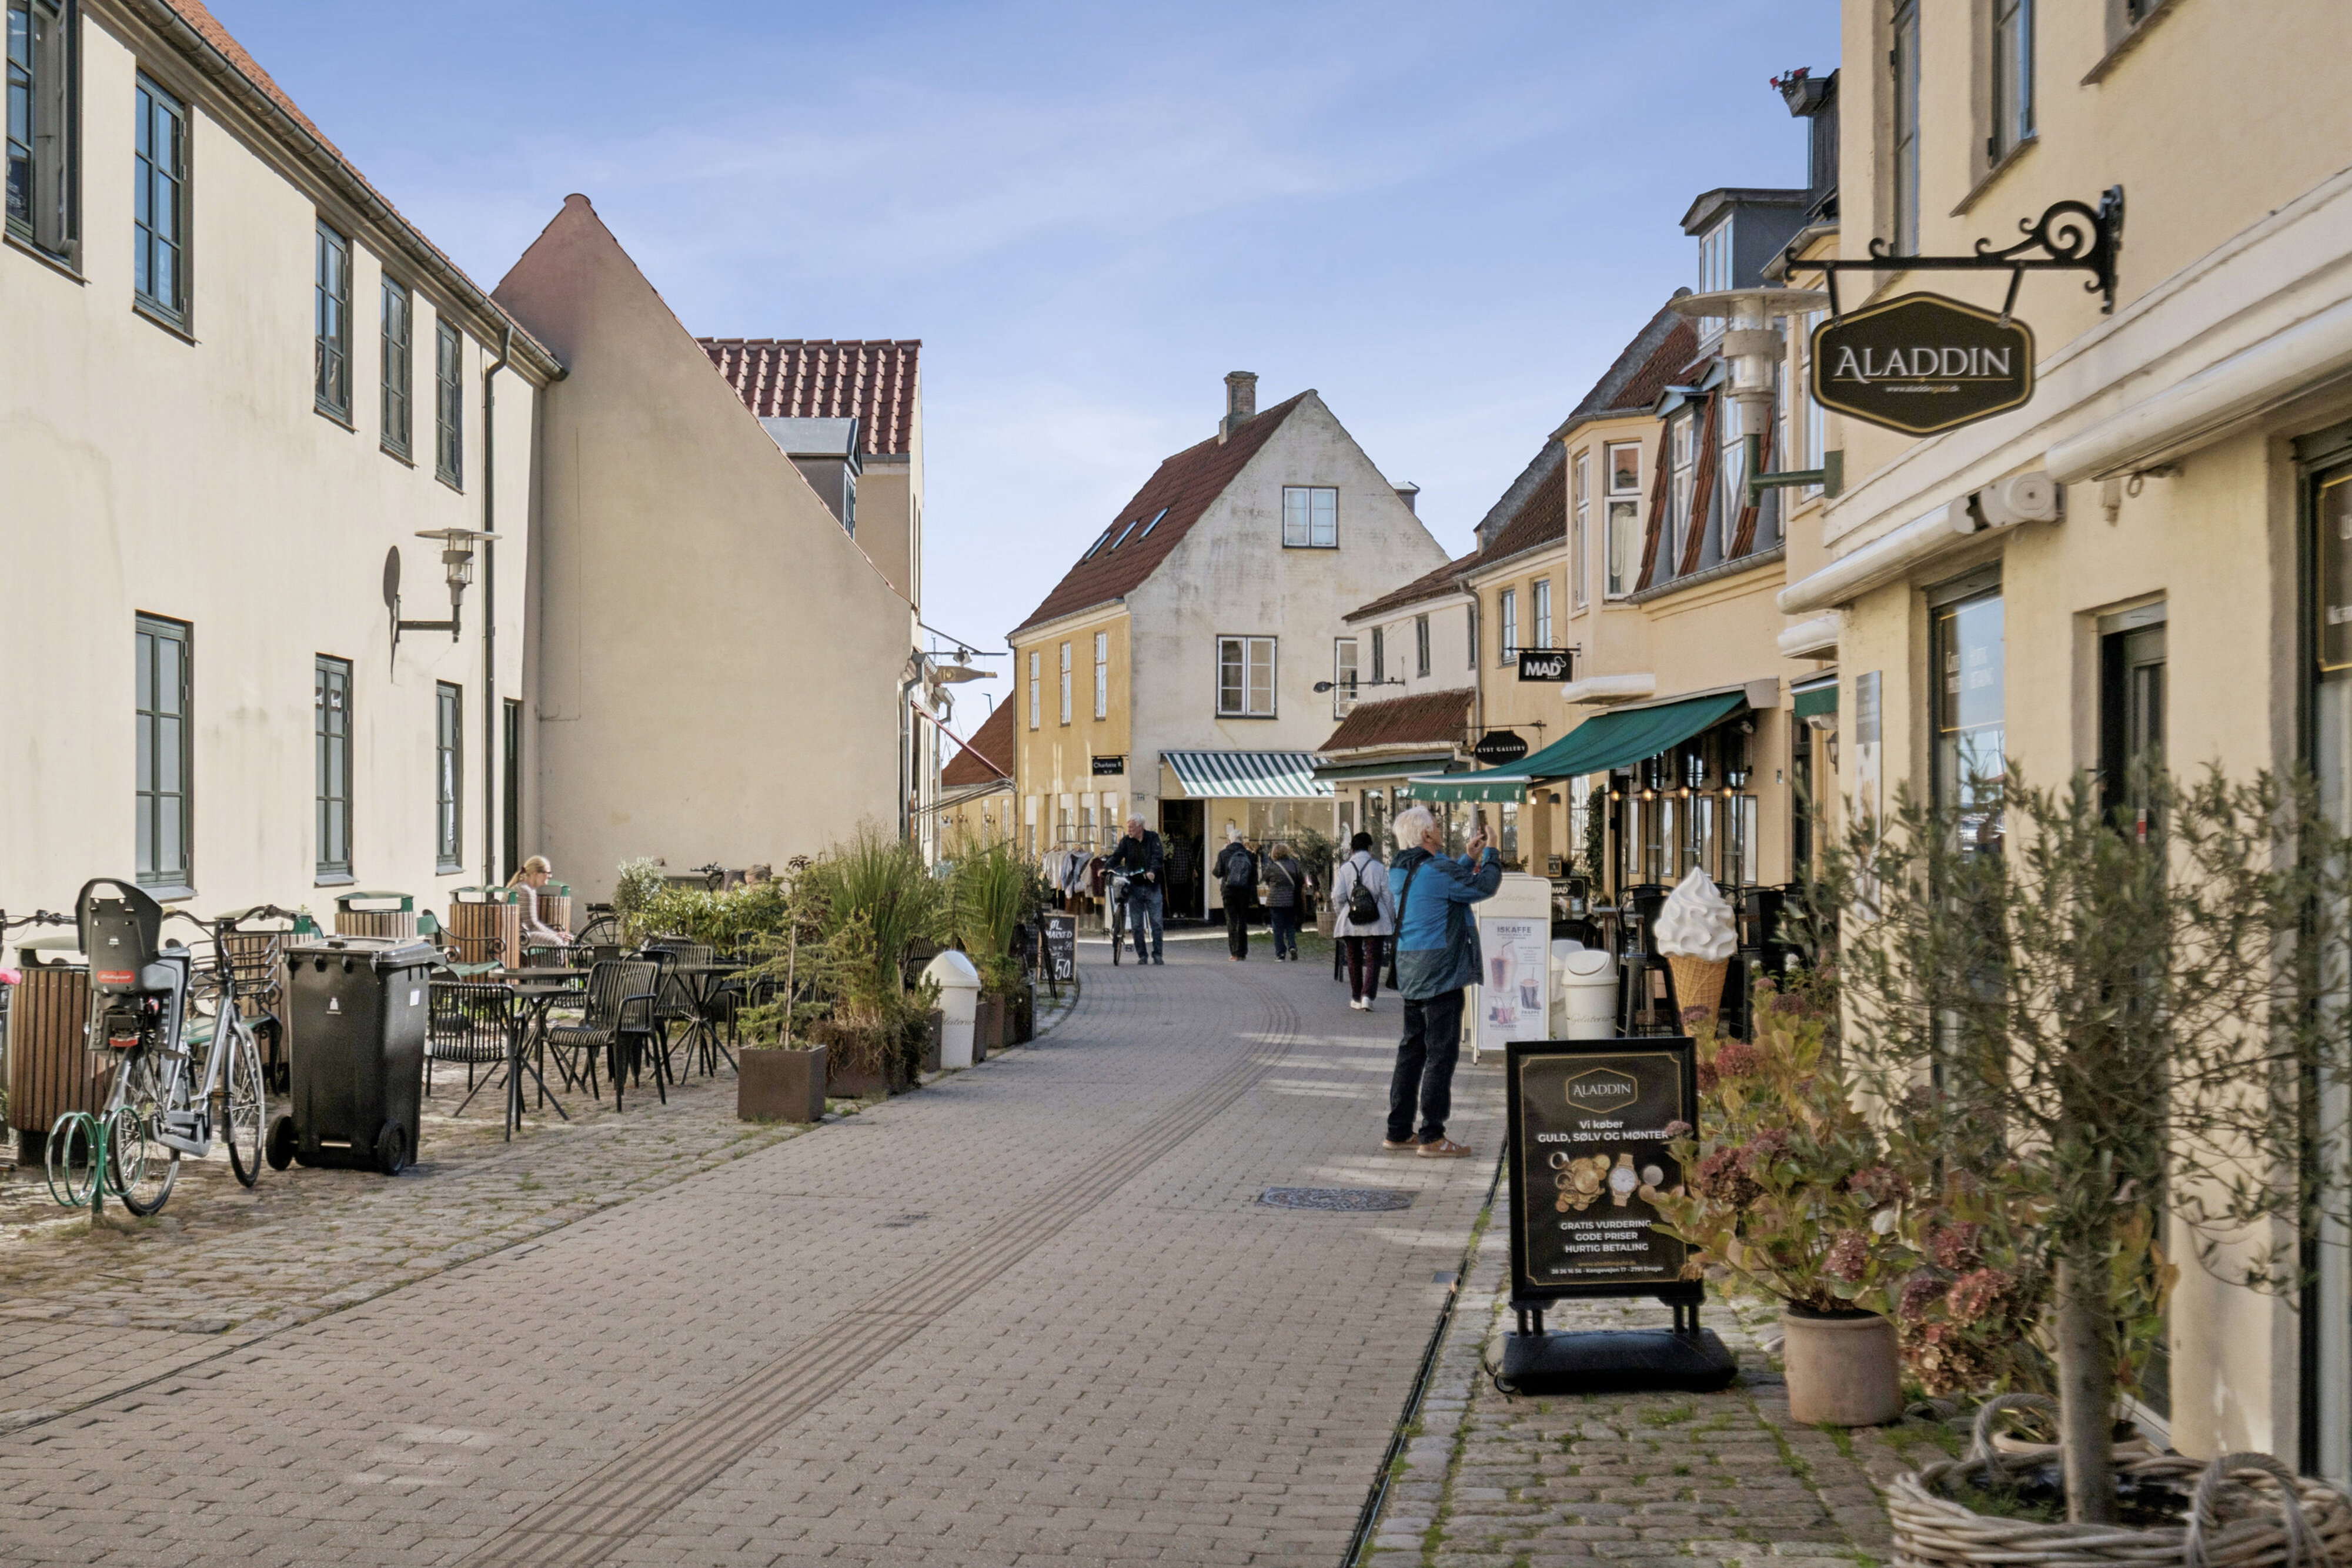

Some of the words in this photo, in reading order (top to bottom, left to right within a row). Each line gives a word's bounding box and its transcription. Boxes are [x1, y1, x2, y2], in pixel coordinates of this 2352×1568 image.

[1834, 346, 2012, 384] ALADDIN
[1525, 662, 1562, 676] MAD
[1573, 1084, 1631, 1098] ALADDIN
[1580, 1120, 1591, 1129] Vi
[1593, 1119, 1624, 1129] køber
[1538, 1134, 1571, 1143] GULD,
[1573, 1132, 1601, 1142] SØLV
[1603, 1132, 1620, 1141] OG
[1623, 1131, 1669, 1140] MØNTER
[1561, 1222, 1595, 1231] GRATIS
[1596, 1220, 1652, 1229] VURDERING
[1575, 1233, 1603, 1241] GODE
[1605, 1232, 1638, 1240] PRISER
[1565, 1245, 1601, 1253] HURTIG
[1603, 1243, 1649, 1252] BETALING
